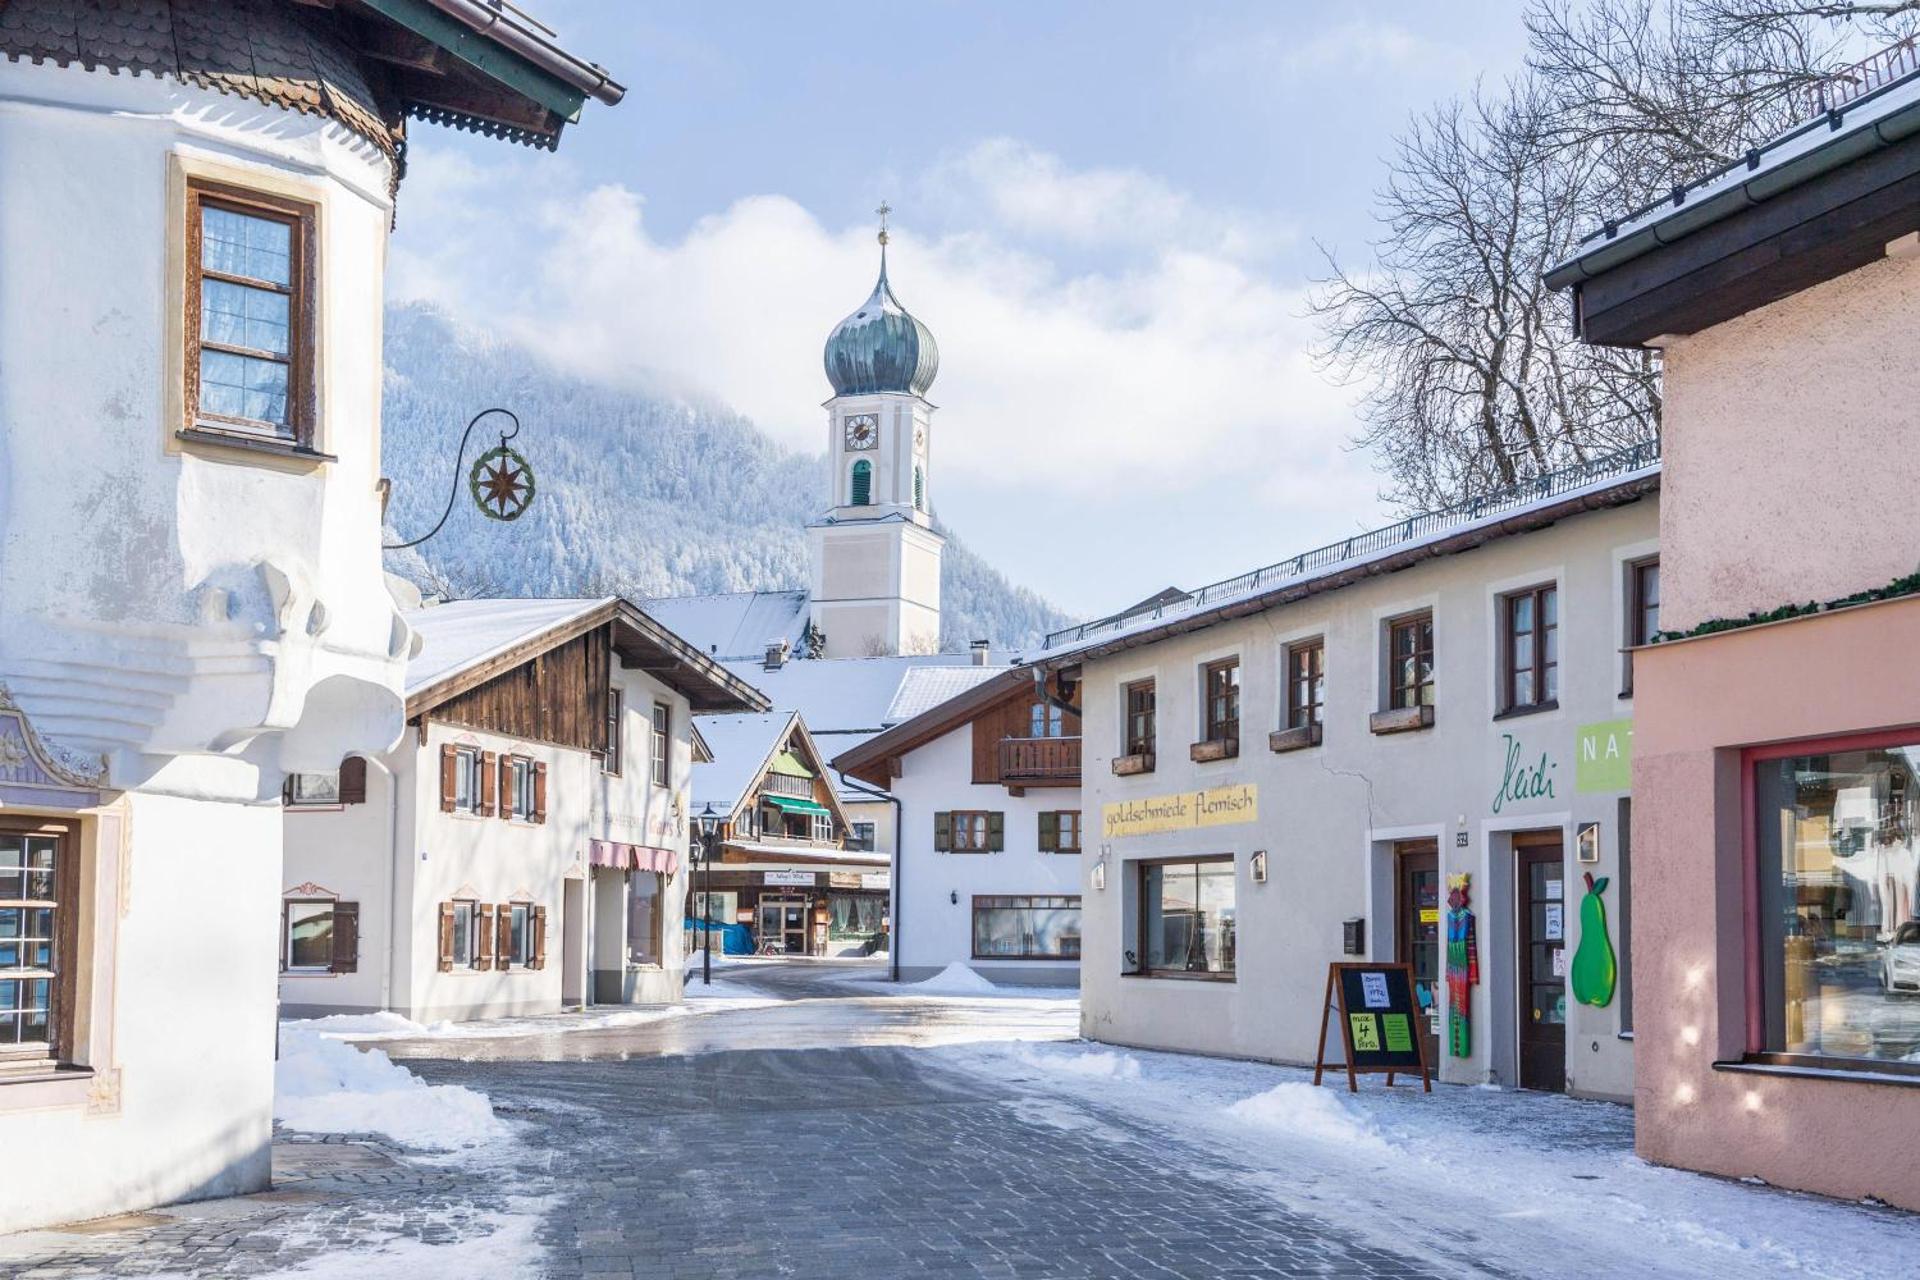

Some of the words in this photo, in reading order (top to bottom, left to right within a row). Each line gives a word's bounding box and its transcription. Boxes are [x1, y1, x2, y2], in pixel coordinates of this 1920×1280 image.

[1583, 731, 1633, 762] NA
[1492, 734, 1557, 814] Heidi
[1106, 796, 1187, 835] goldschmiede
[1359, 1023, 1370, 1037] 4
